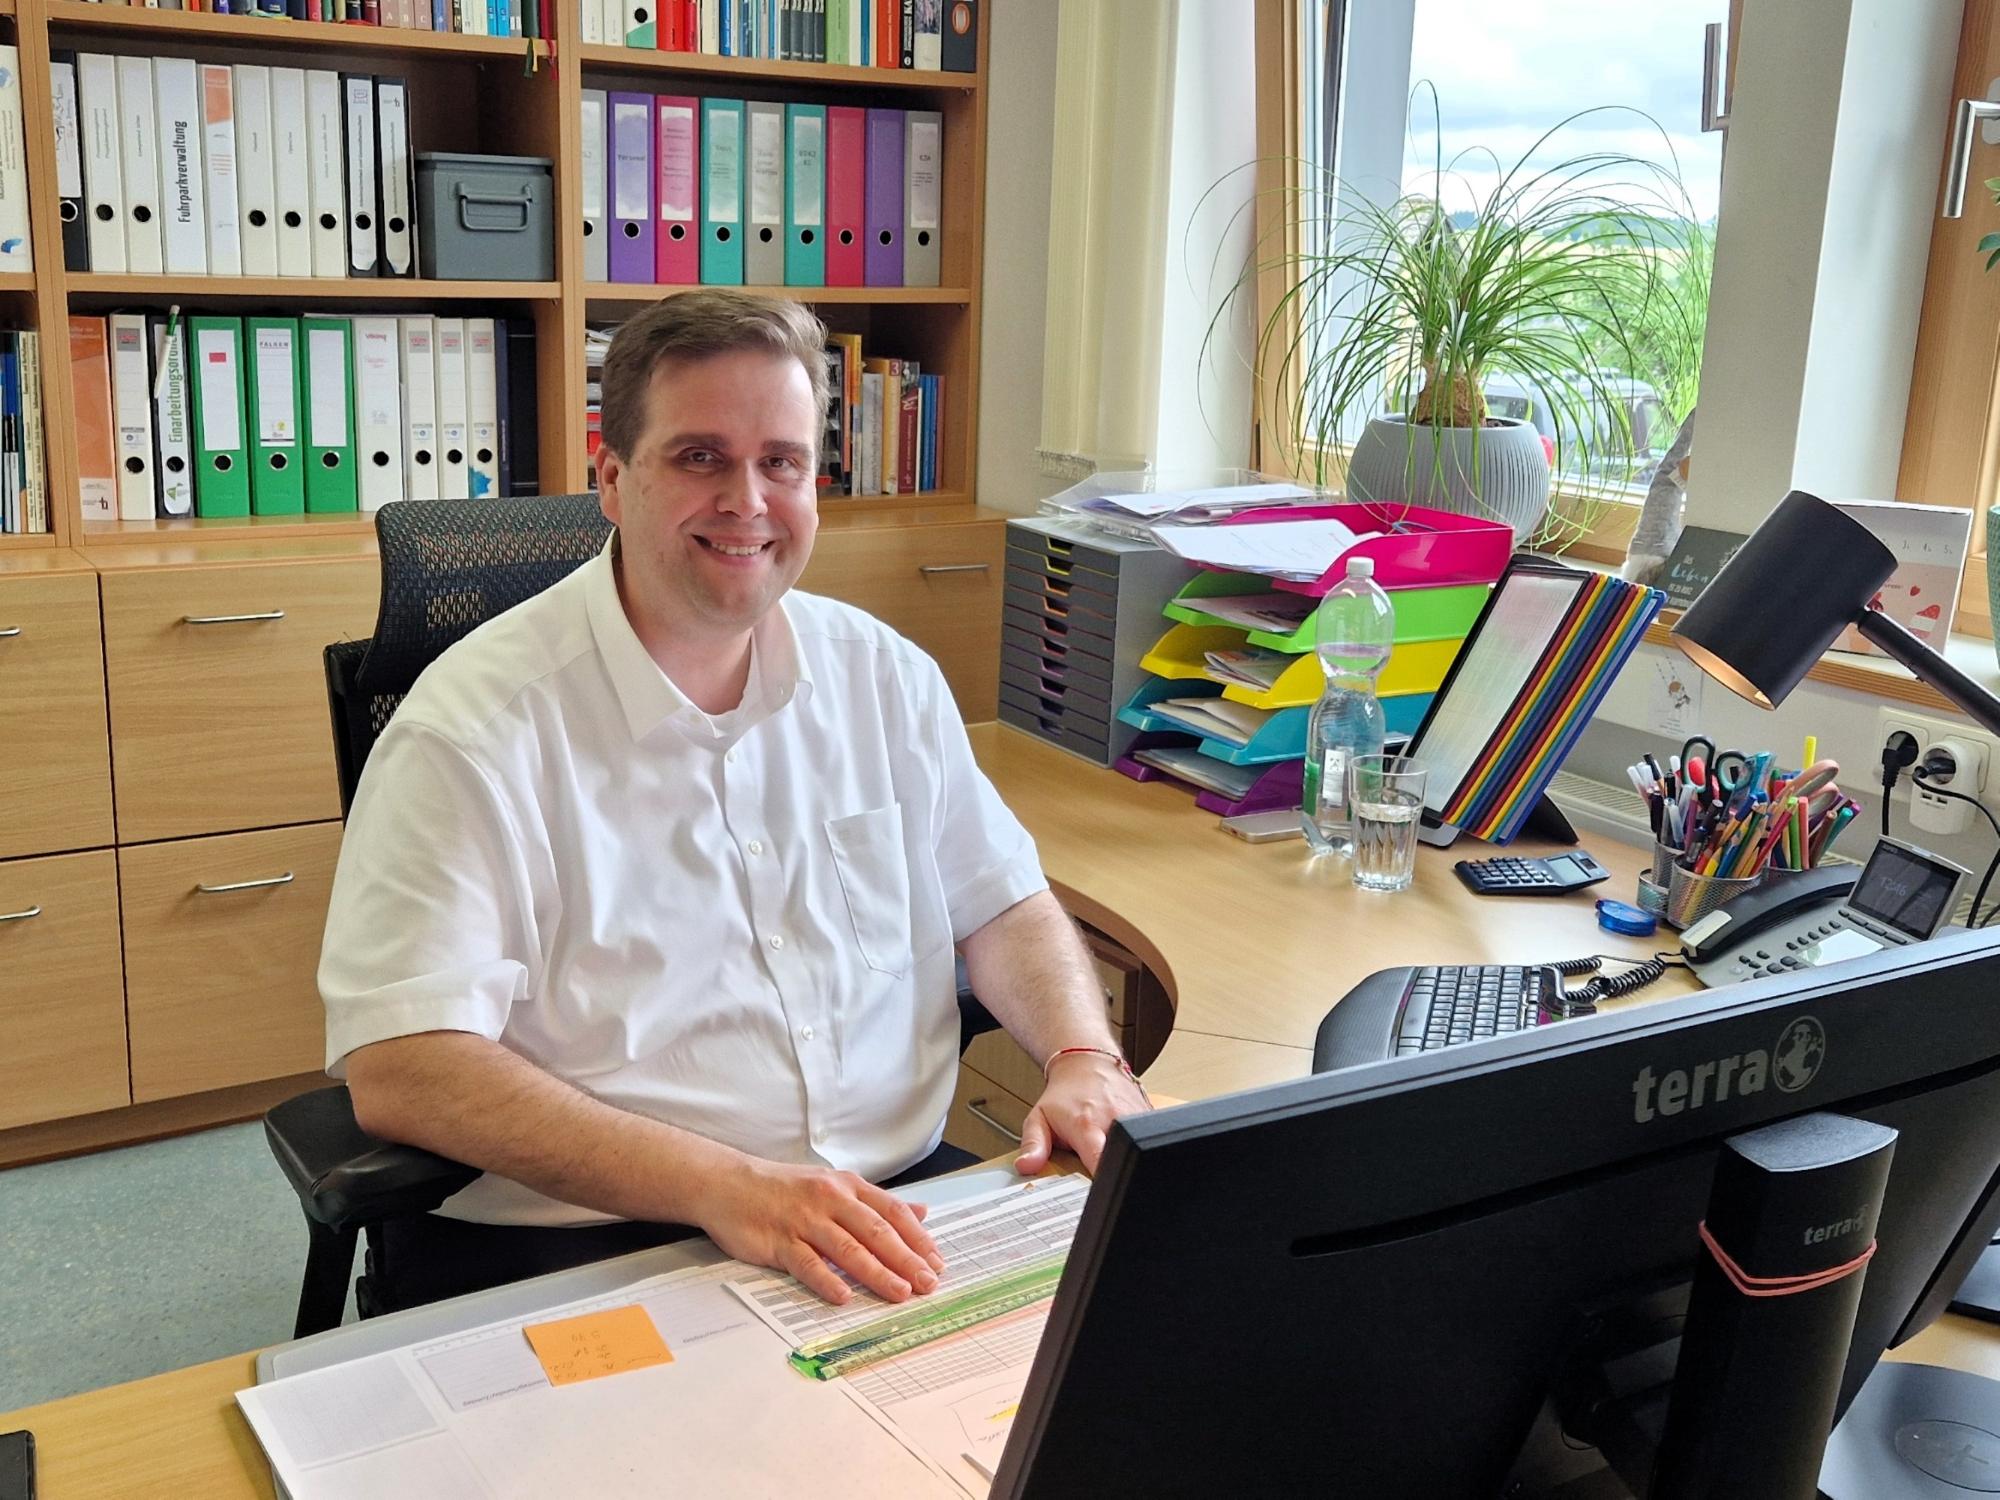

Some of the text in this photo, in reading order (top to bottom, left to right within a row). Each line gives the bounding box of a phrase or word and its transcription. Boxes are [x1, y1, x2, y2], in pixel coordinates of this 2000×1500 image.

[173, 120, 193, 223] Fuhrparkverwaltung
[891, 361, 899, 375] 3
[1632, 1048, 1768, 1124] terra
[1803, 1216, 1852, 1246] terra
